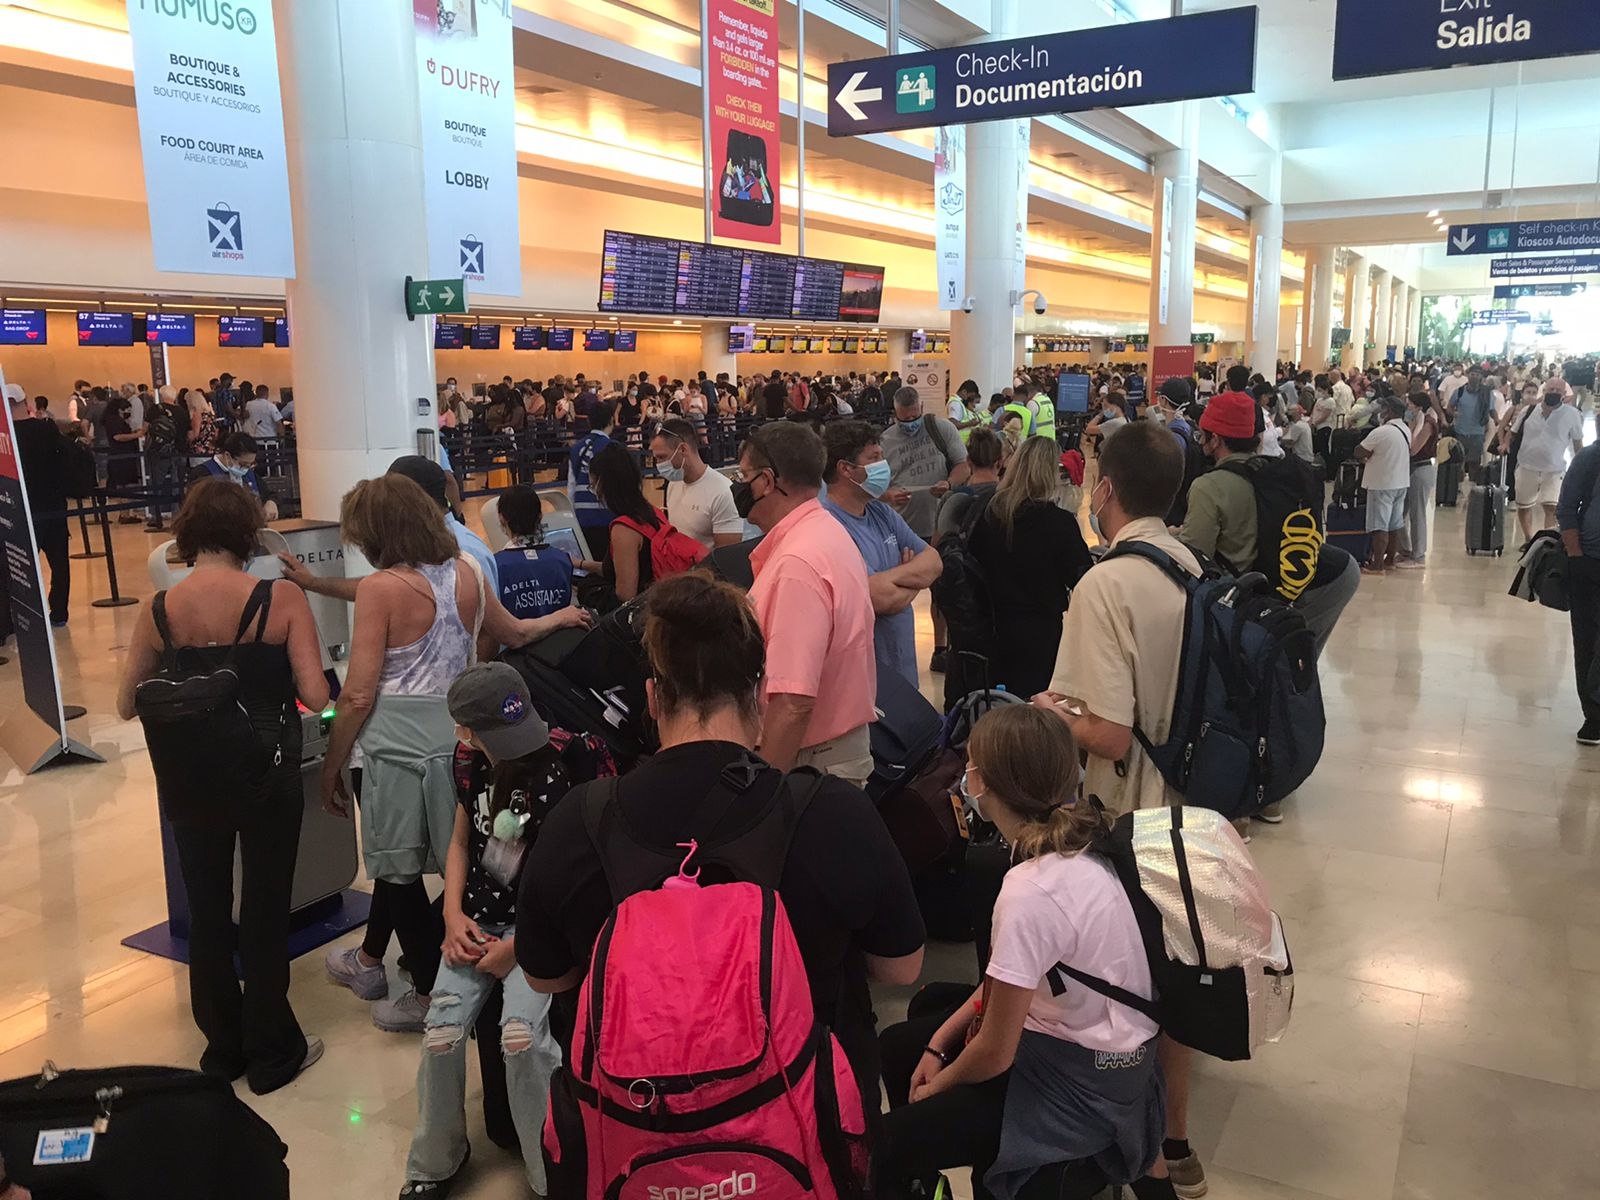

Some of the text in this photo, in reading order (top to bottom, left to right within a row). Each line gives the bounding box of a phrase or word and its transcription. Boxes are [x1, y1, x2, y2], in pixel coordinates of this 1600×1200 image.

[725, 29, 736, 40] and
[1437, 13, 1531, 49] Salida
[169, 53, 240, 78] BOUTIQUE &
[955, 44, 1049, 78] Check-In
[167, 71, 246, 96] ACCESSORIES
[441, 65, 500, 99] DUFRY
[723, 66, 747, 86] boarding
[955, 65, 1142, 108] Documentación
[153, 86, 261, 114] BOUTIQUE Y ACCESORIOS
[726, 94, 746, 109] CHECK
[444, 120, 487, 137] BOUTIQUE
[160, 135, 264, 160] FOOD COURT AREA
[452, 135, 483, 148] BOUTIQUE
[207, 155, 218, 165] DE
[220, 157, 248, 169] COMIDA
[445, 169, 489, 191] LOBBY
[1519, 223, 1540, 235] Self
[1543, 222, 1589, 234] check-in
[1517, 237, 1553, 247] Kioscos
[1492, 260, 1507, 268] Ticket
[1528, 259, 1554, 267] Passenger
[1574, 264, 1598, 272] pasajero
[296, 549, 344, 564] DELTA
[512, 579, 540, 591] DELTA
